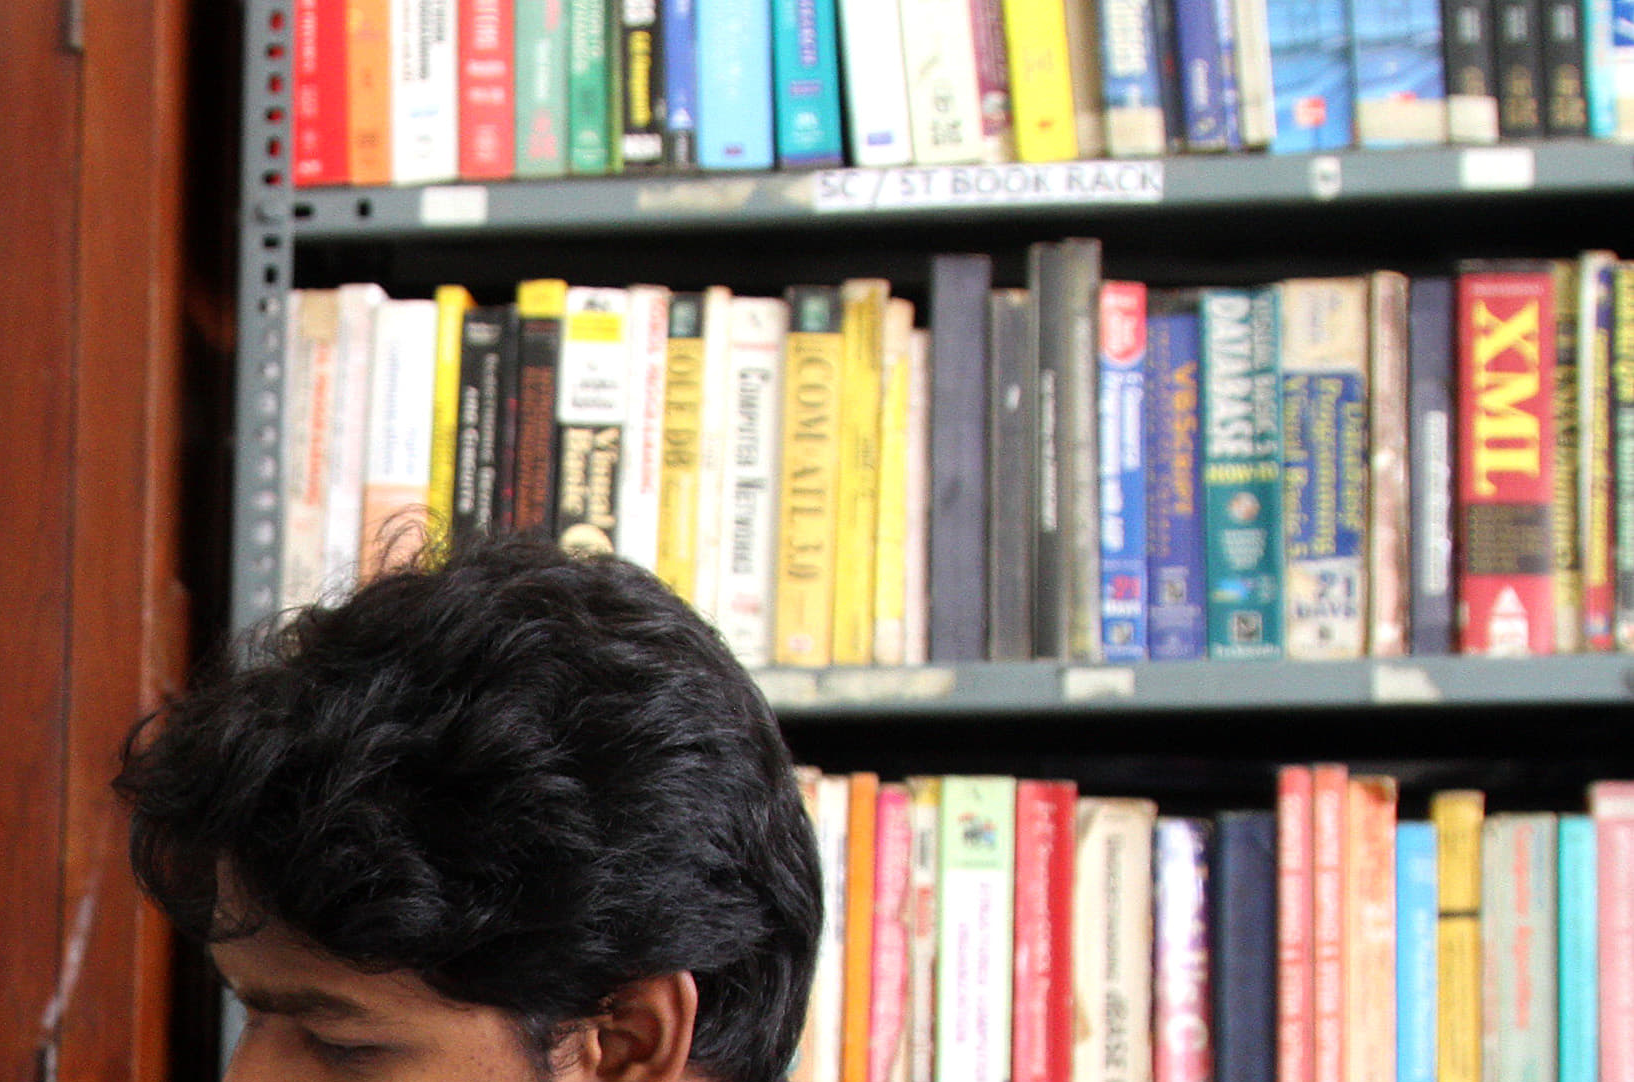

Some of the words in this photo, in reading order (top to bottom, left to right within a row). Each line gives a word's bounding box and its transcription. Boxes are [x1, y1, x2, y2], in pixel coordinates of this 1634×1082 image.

[952, 164, 1050, 197] BOOK
[1064, 161, 1162, 194] RACK
[666, 354, 701, 417] OLE
[737, 366, 775, 467] COMPUTER
[1208, 294, 1253, 459] DATABASE
[1472, 298, 1542, 497] XML
[558, 427, 593, 516] Basic
[585, 427, 622, 529] Visual
[732, 476, 771, 576] NETWORKS
